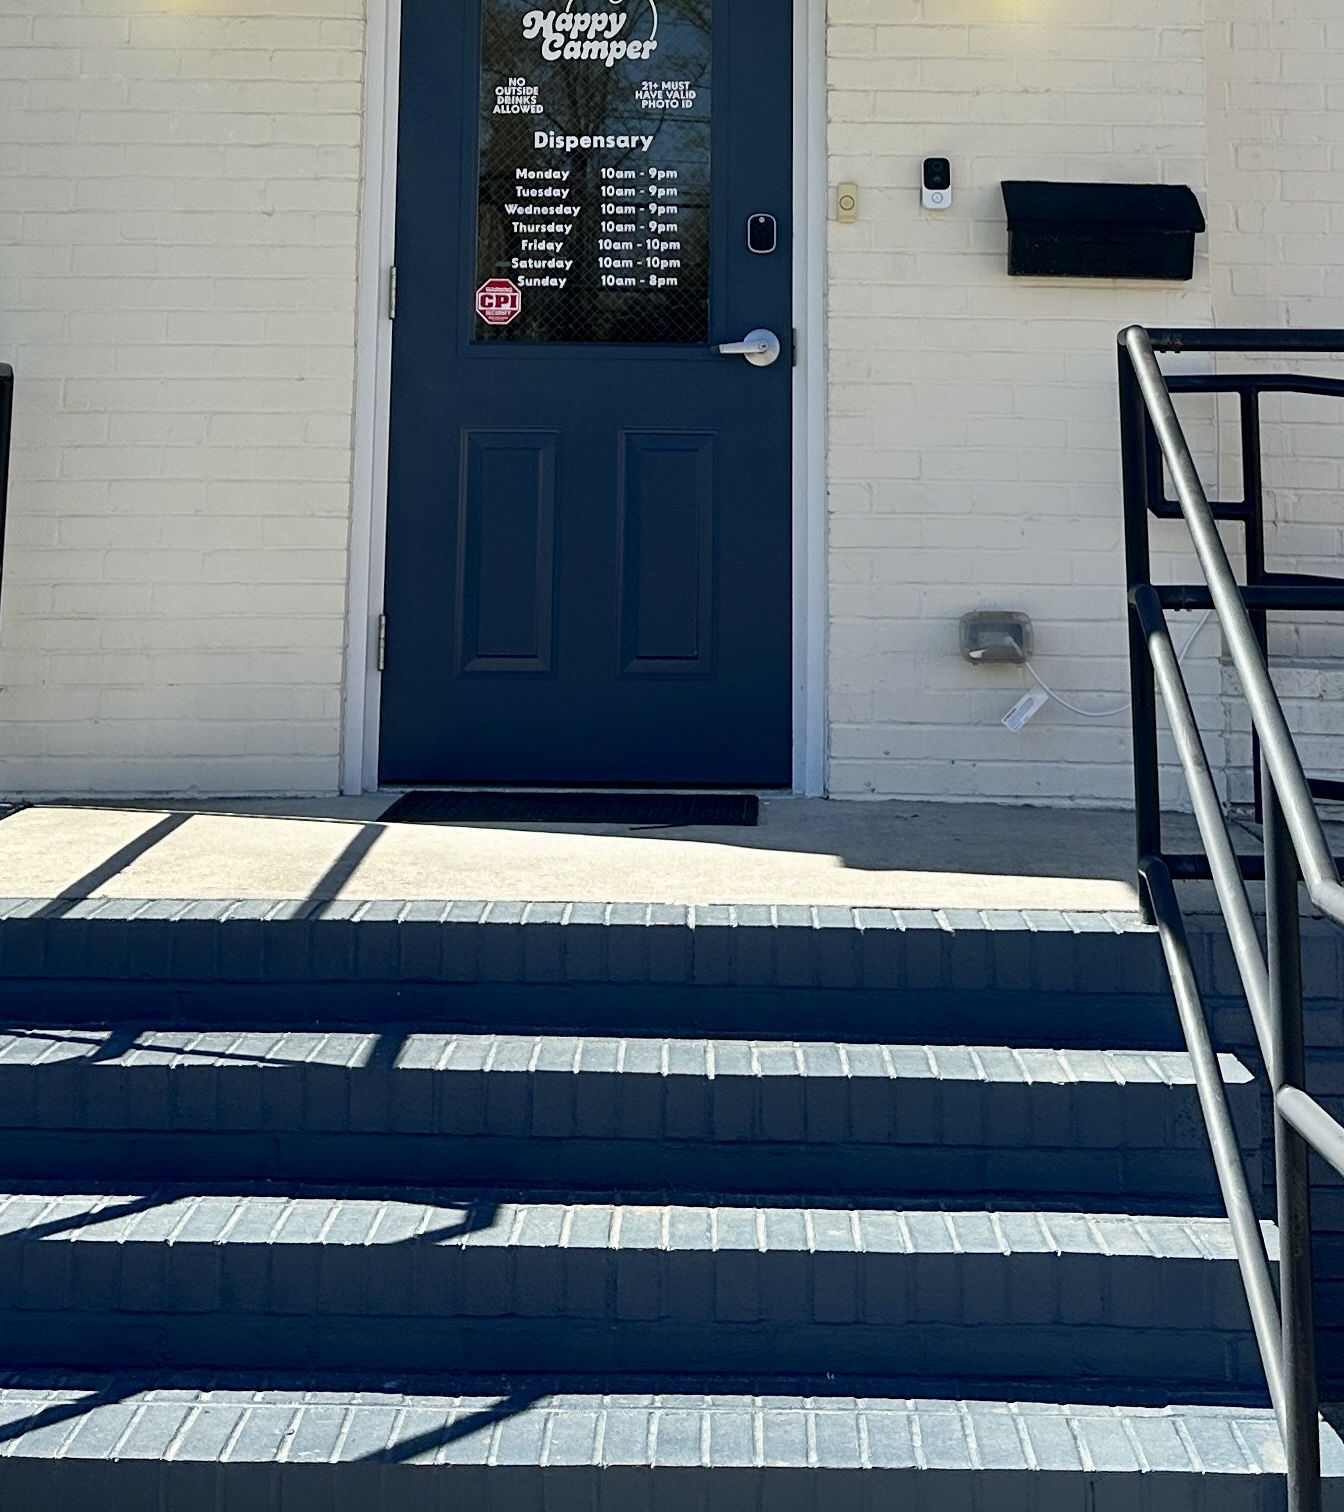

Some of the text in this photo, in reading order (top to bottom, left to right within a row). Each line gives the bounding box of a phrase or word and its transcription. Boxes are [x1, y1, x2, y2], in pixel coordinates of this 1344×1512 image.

[522, 10, 627, 39] Happy
[541, 33, 658, 67] Camper
[508, 77, 526, 87] NO
[641, 81, 691, 90] 21+ MUST
[495, 86, 539, 96] OUTSIDE
[635, 90, 696, 99] HAVE VALID
[496, 95, 537, 105] DRINKS
[641, 99, 693, 108] PHOTO ID
[492, 104, 544, 114] ALLOWED
[534, 131, 654, 151] Dispensary
[515, 168, 570, 181] Monday
[600, 168, 636, 179] 10am
[648, 168, 678, 181] 9pm
[515, 185, 570, 199] Tuesday
[600, 185, 636, 196] 10am
[648, 185, 678, 198] 9pm
[504, 203, 581, 217] Wednesday
[600, 203, 636, 214] 10am
[648, 203, 678, 216] 9pm
[511, 221, 573, 235] Thursday
[600, 221, 636, 232] 10am
[648, 221, 678, 234] 9pm
[521, 239, 564, 253] Friday
[598, 239, 633, 250] 10am
[645, 239, 681, 252] 10pm
[511, 257, 574, 271] Saturday
[598, 256, 633, 267] 10am
[645, 256, 681, 269] 10pm
[517, 275, 567, 288] Sunday
[600, 274, 636, 285] 10am
[648, 274, 678, 287] 8pm
[480, 294, 517, 308] CPI
